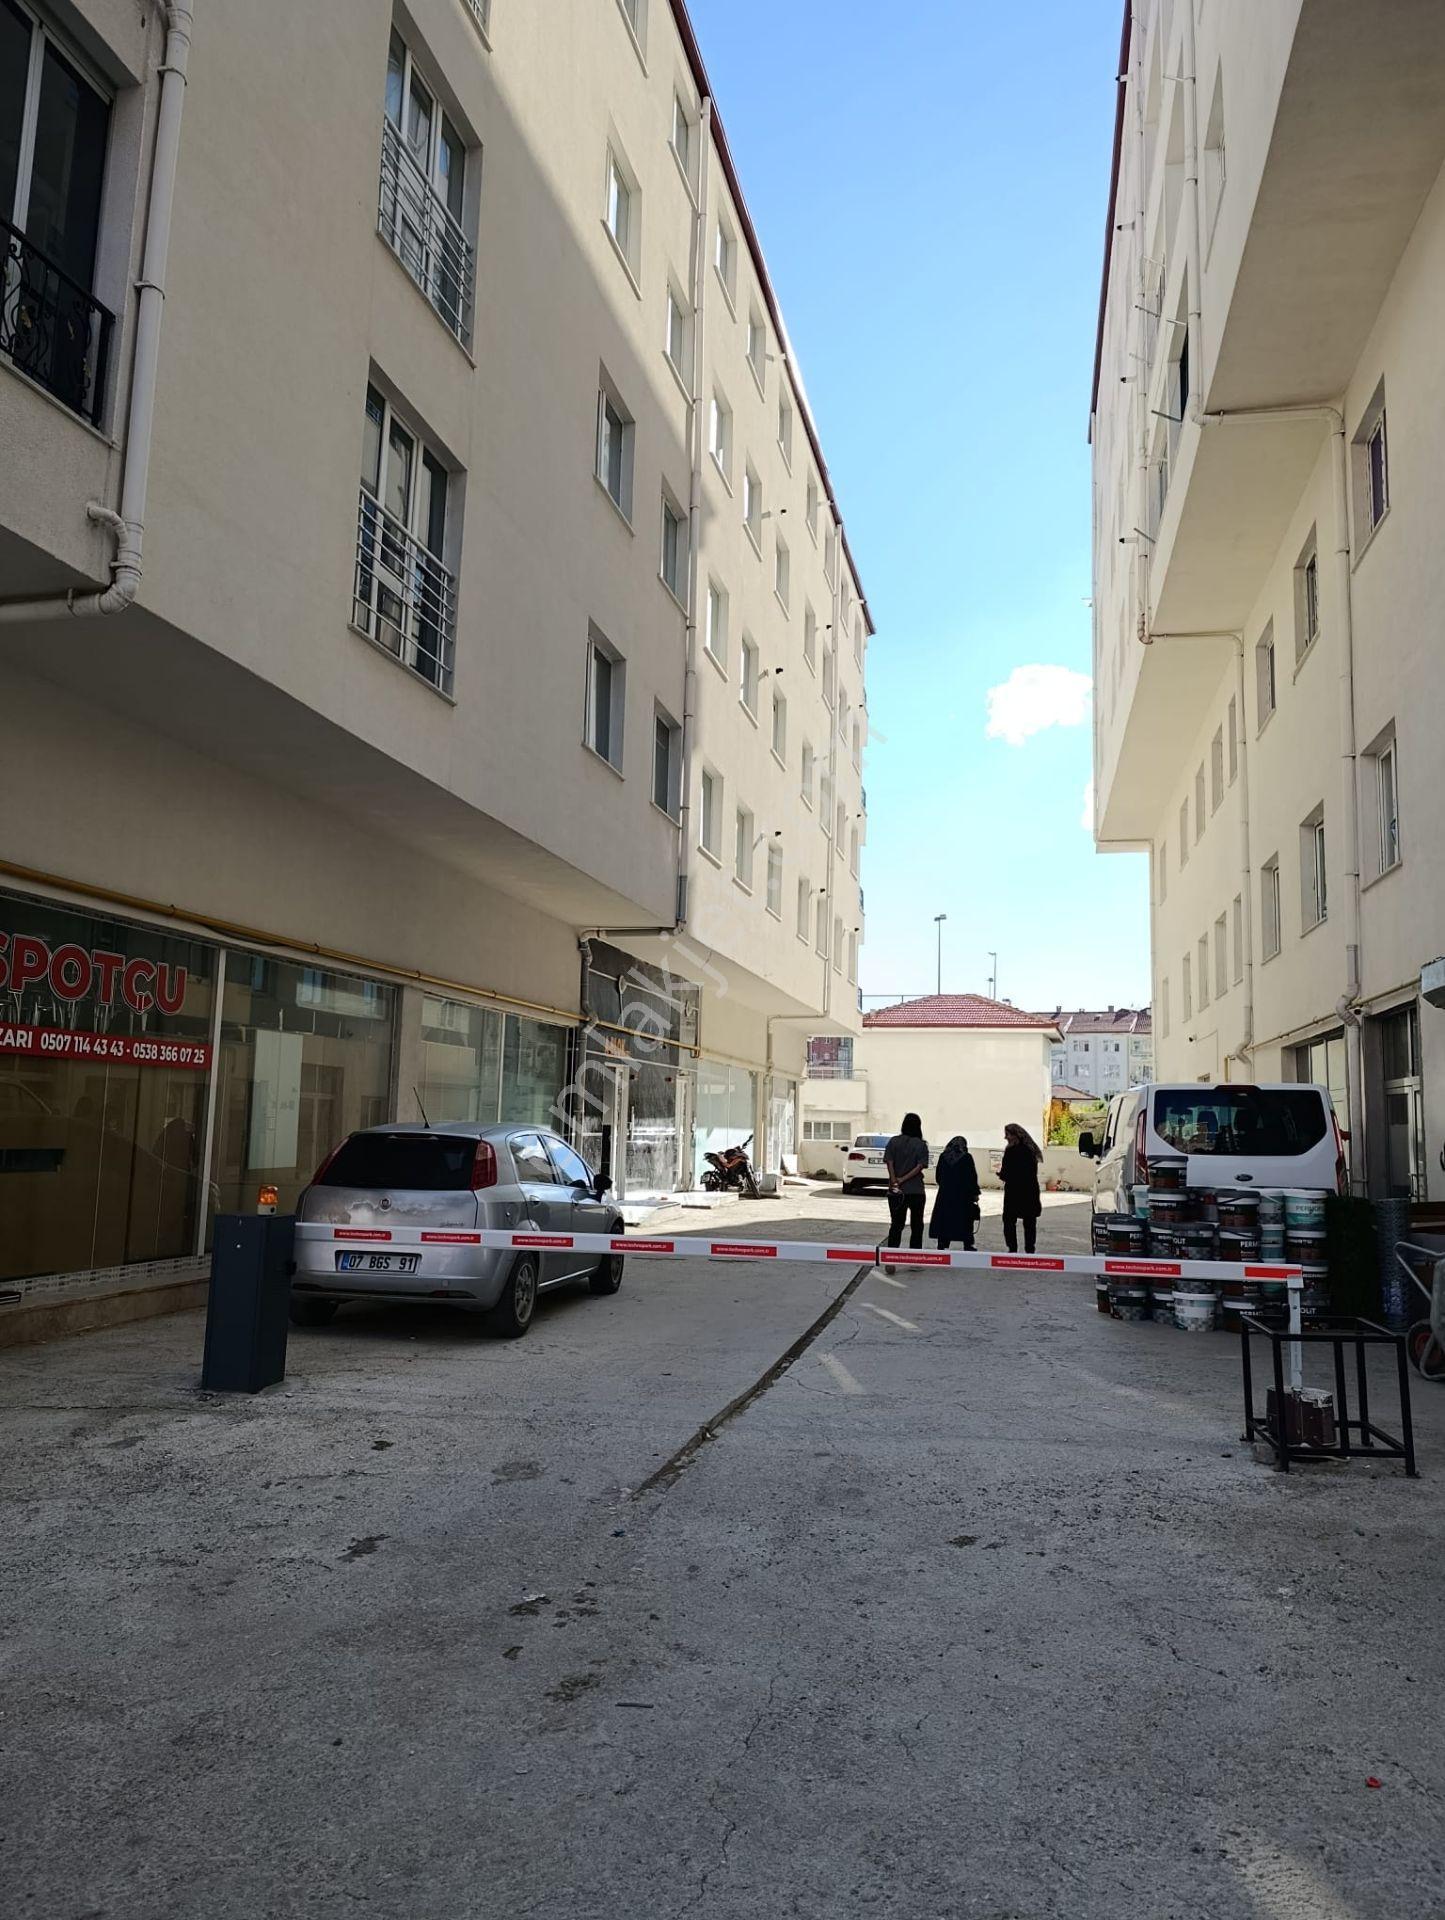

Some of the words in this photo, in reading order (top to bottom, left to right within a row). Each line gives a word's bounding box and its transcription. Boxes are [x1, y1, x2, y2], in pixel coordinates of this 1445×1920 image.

[41, 1032, 72, 1051] 0507
[74, 1036, 91, 1053] 114
[93, 1038, 108, 1055] 43
[110, 1040, 124, 1057] 43
[133, 1042, 158, 1060] 0538
[160, 1045, 178, 1062] 366
[180, 1047, 192, 1063] 07
[193, 1049, 205, 1064] 25
[349, 1256, 363, 1268] 07
[369, 1256, 391, 1269] BGS
[399, 1257, 413, 1270] 91
